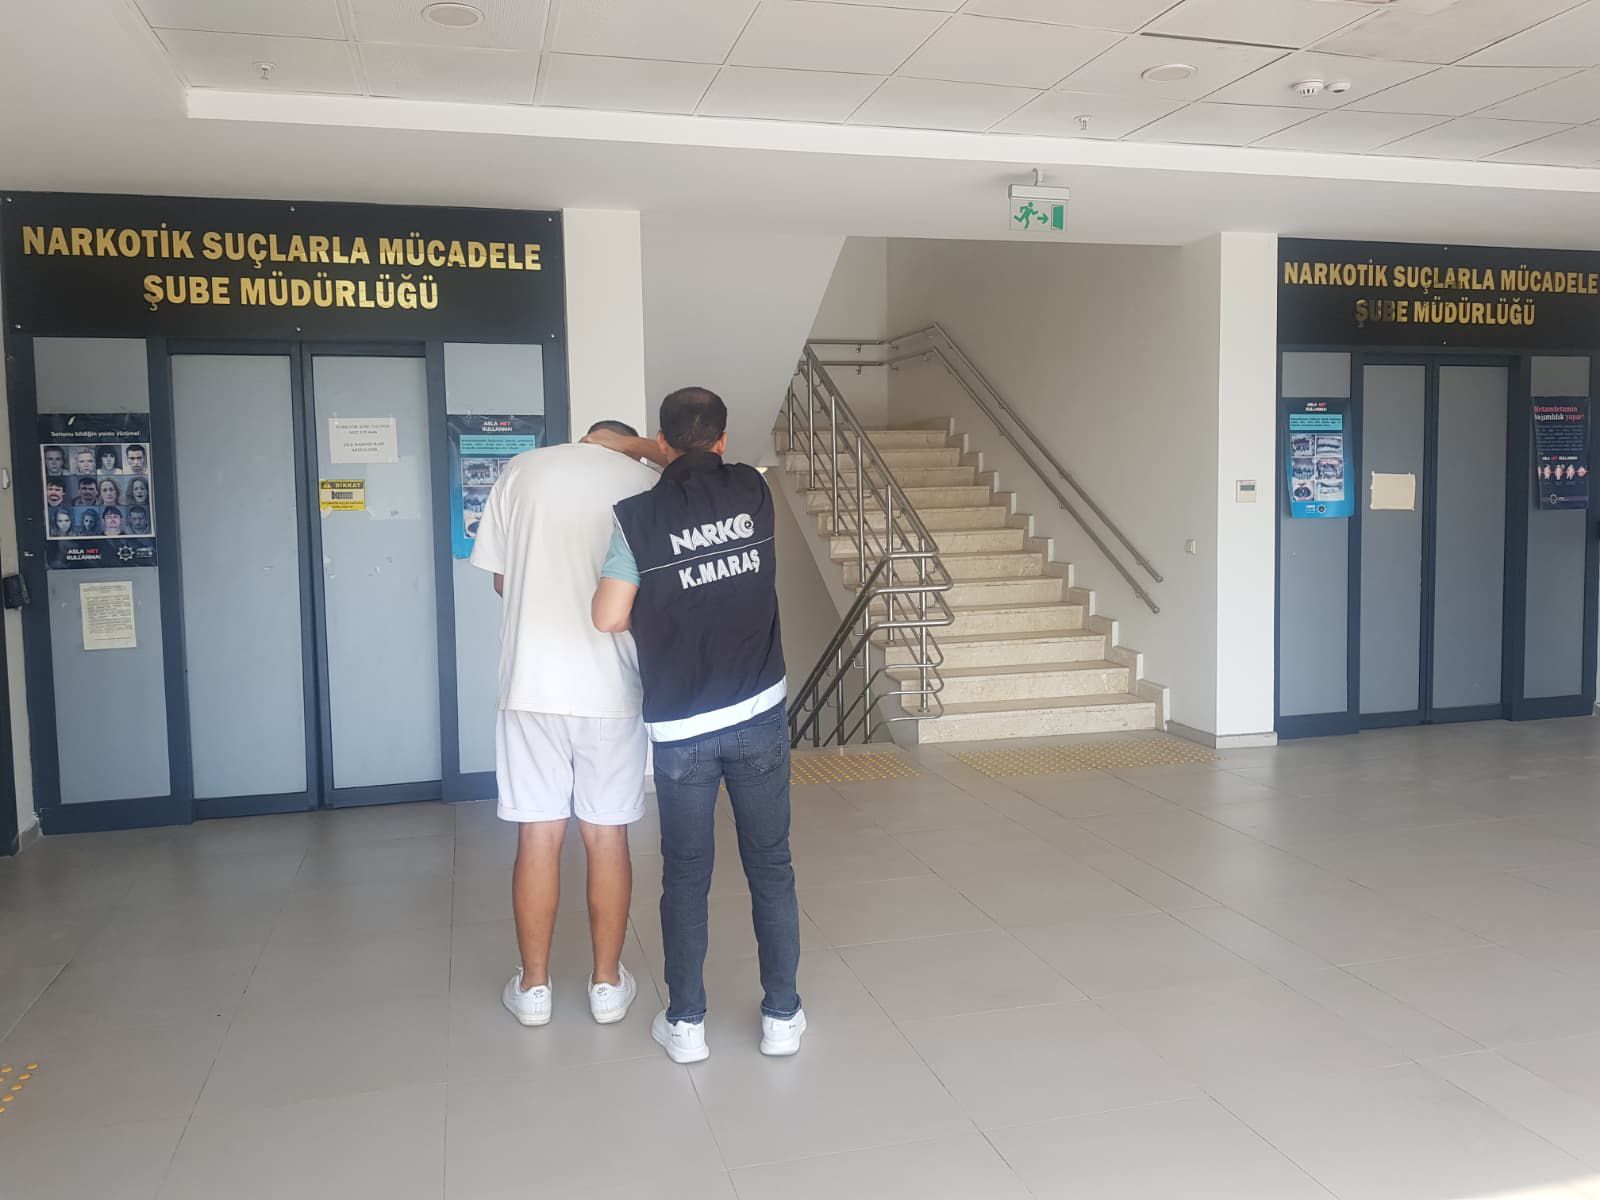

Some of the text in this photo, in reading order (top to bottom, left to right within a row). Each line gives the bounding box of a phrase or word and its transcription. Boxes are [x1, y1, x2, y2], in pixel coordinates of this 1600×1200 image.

[22, 222, 542, 270] NARKOTİK SUÇLARLA MÜCADELE
[143, 270, 439, 312] ŞUBE MÜDÜRLÜĞÜ
[1284, 258, 1599, 294] NARKOTİK SUÇLARLA MÜCADELE
[1355, 295, 1536, 328] ŞUBE MÜDÜRLÜĞÜ
[669, 512, 755, 556] NARKO
[678, 548, 761, 590] K.MARAŞ
